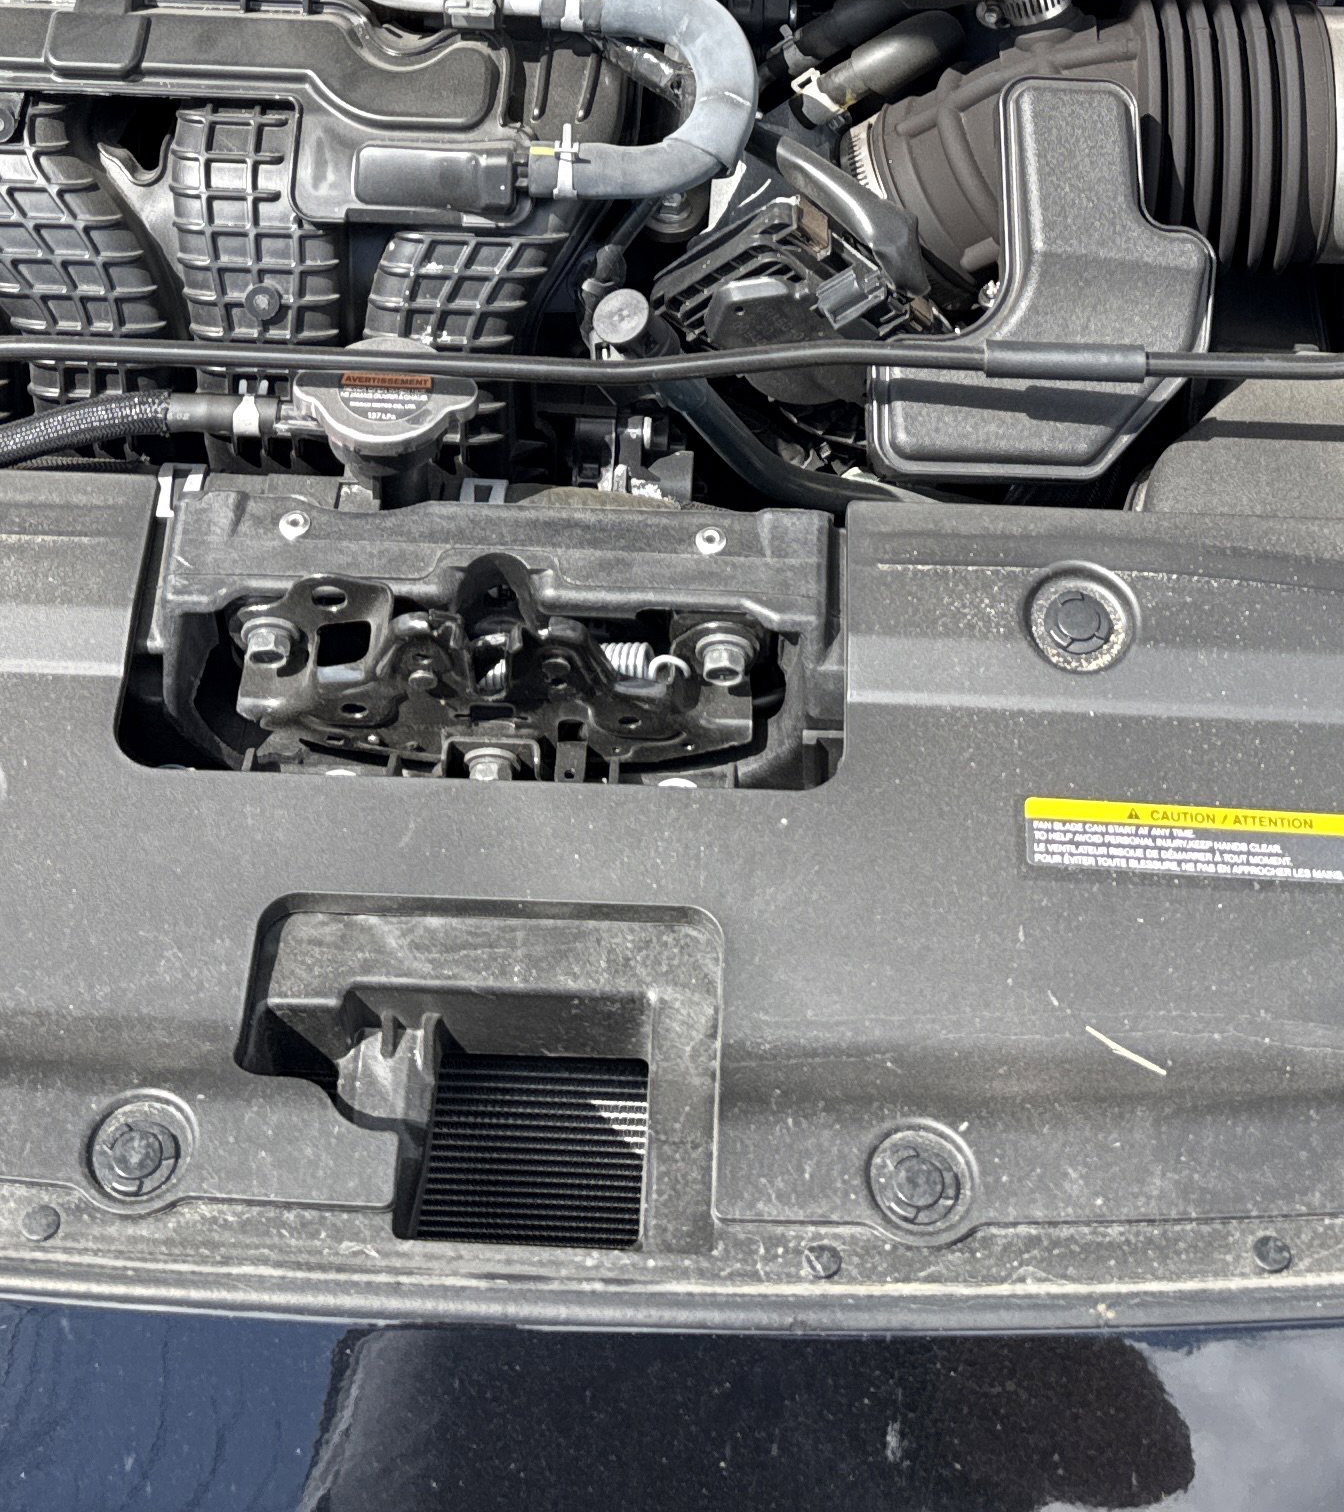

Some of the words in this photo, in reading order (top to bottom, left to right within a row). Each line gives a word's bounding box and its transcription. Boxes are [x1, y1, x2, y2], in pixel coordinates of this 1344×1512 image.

[345, 375, 429, 386] AVERTISSEMENT
[1033, 821, 1051, 829] FAN
[1054, 822, 1083, 831] BLADE
[1085, 824, 1106, 833] CAN
[1108, 825, 1136, 834] START
[1138, 826, 1149, 835] AT
[1150, 827, 1170, 836] ANY
[1151, 810, 1215, 824] CAUTION
[1232, 814, 1313, 829] ATTENTION
[1034, 831, 1047, 840] TO
[1048, 832, 1073, 842] HELP
[1074, 833, 1103, 843] AVOID
[1104, 835, 1154, 846] PERSONAL
[1214, 841, 1248, 852] HANDS
[1034, 842, 1045, 851] LE
[1047, 843, 1107, 855] VENTILATEUR
[1109, 847, 1144, 857] RISQUE
[1146, 849, 1159, 858] DE
[1224, 853, 1247, 863] TOUT
[1034, 853, 1062, 863] POUR
[1097, 857, 1127, 867] TOUTE
[1217, 864, 1231, 874] EN
[1233, 865, 1291, 877] APPROCHER
[1293, 868, 1311, 878] LES
